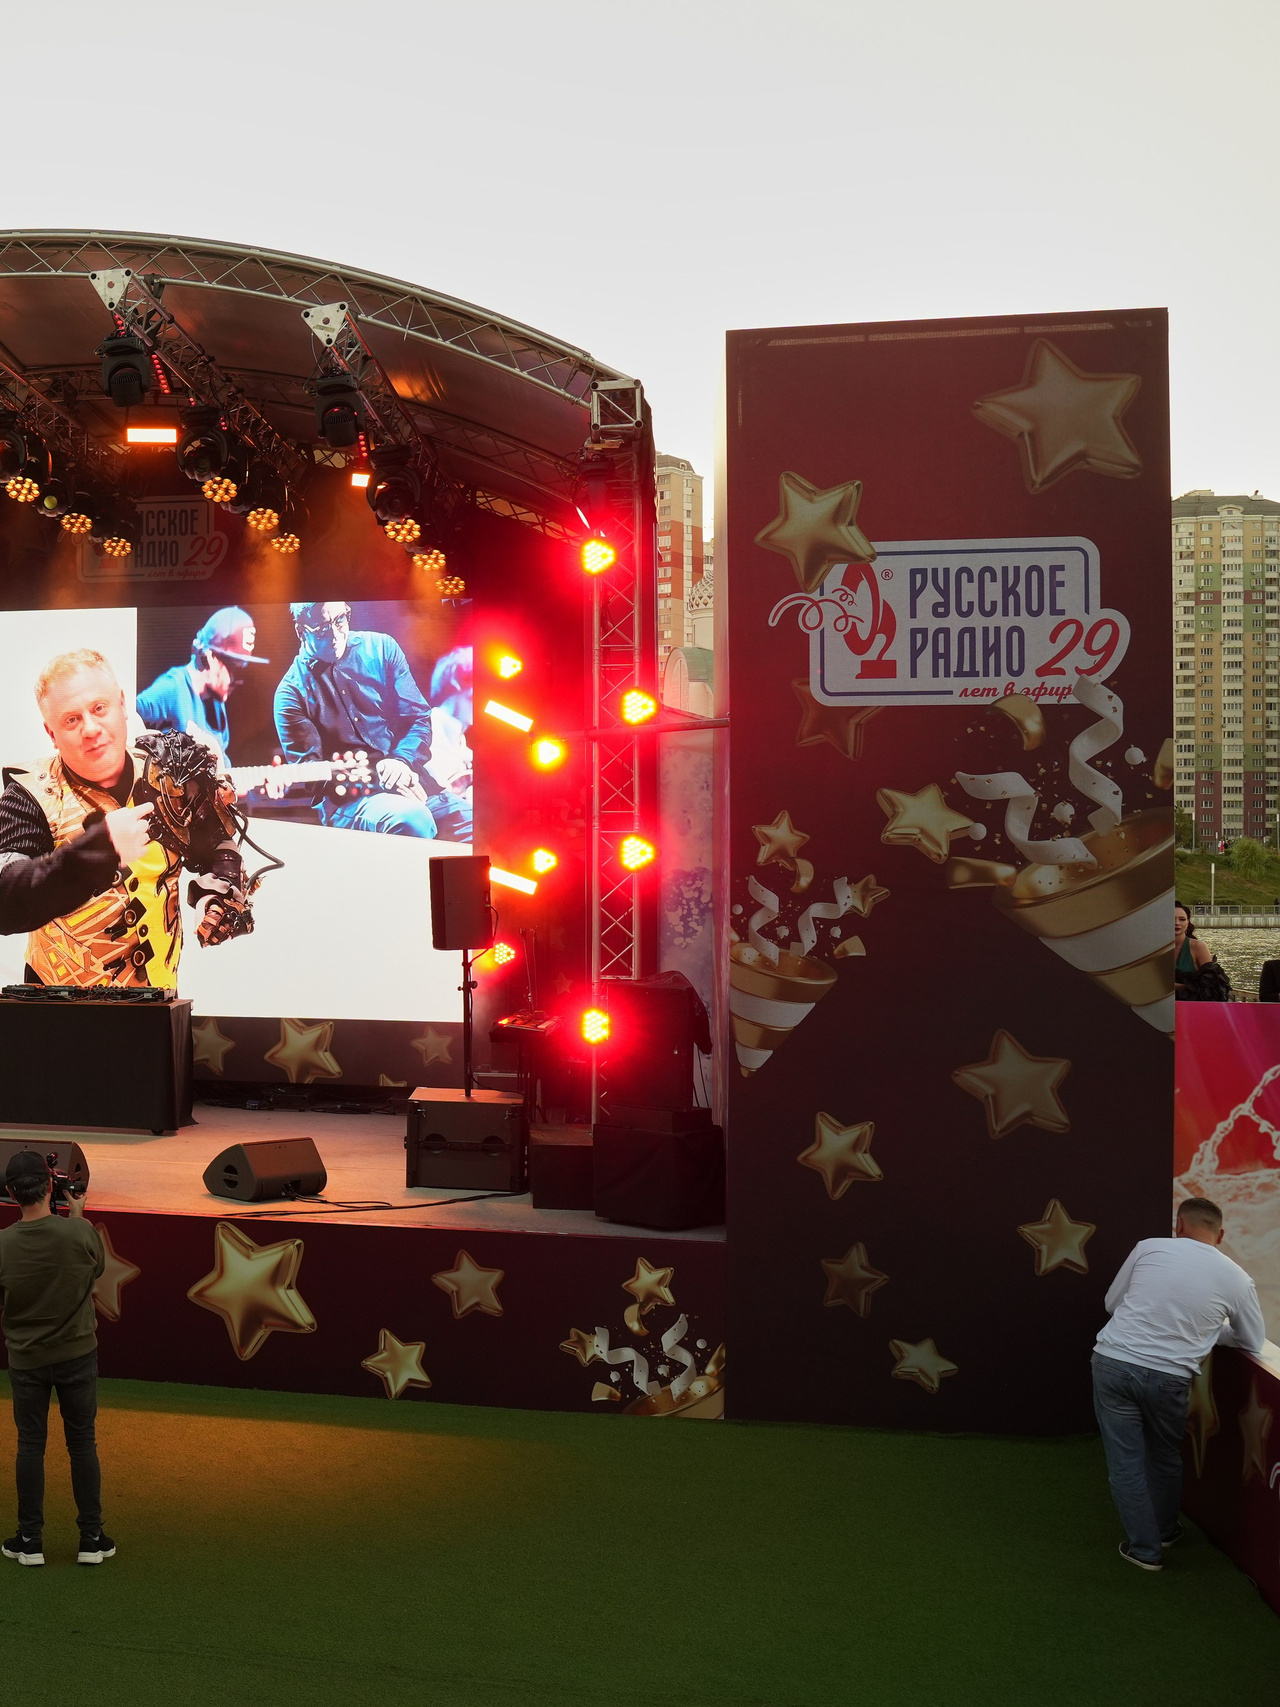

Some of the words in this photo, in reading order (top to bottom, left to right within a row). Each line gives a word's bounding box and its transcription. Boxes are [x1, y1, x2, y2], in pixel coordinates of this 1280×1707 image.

[140, 508, 198, 537] ССКОЕ
[183, 535, 224, 567] 29
[146, 571, 166, 579] лет
[168, 568, 174, 577] в
[176, 568, 207, 580] эфире
[908, 564, 1066, 619] РУССКОЕ
[909, 625, 1026, 679] РАДИО
[1034, 617, 1120, 678] 29
[958, 687, 999, 698] лет
[1003, 681, 1016, 696] в
[1019, 681, 1073, 704] эфир
